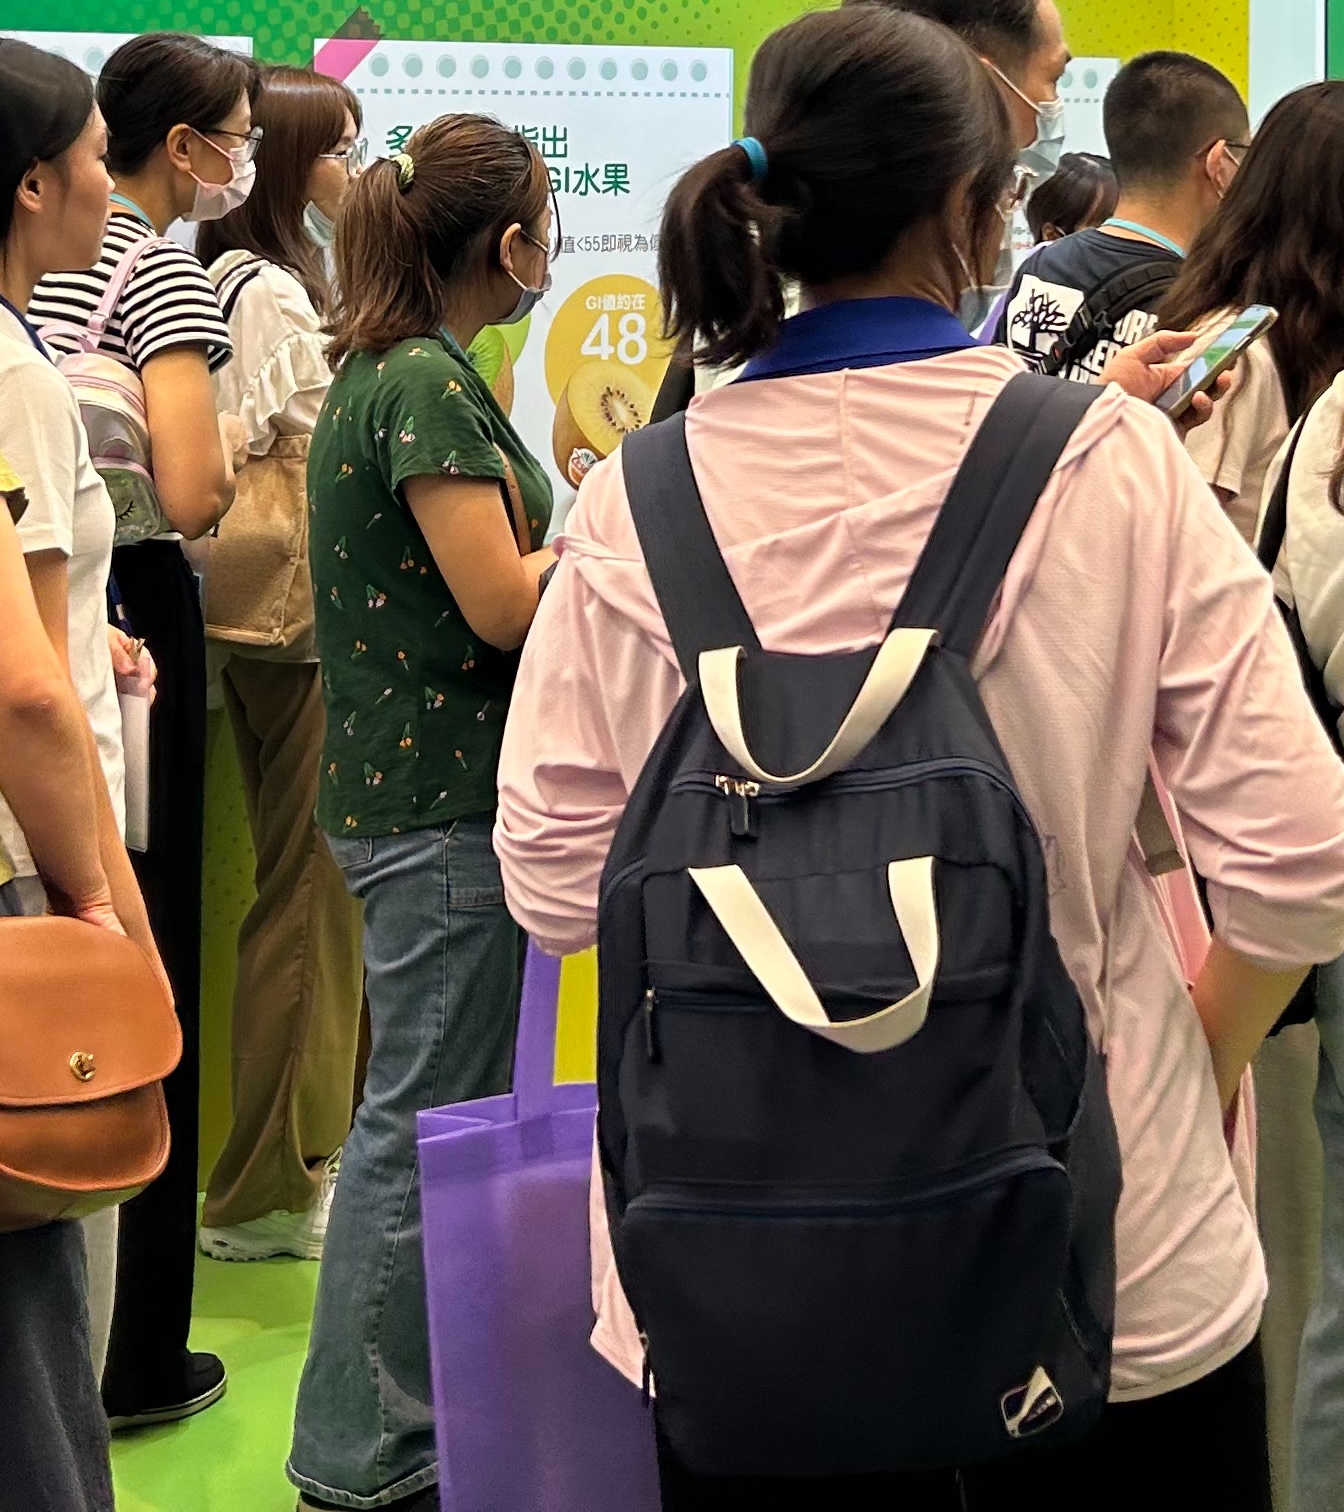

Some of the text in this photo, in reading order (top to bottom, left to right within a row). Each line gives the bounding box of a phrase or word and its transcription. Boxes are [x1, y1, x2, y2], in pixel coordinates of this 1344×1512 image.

[585, 293, 646, 311] GI值約在
[580, 312, 648, 365] 48
